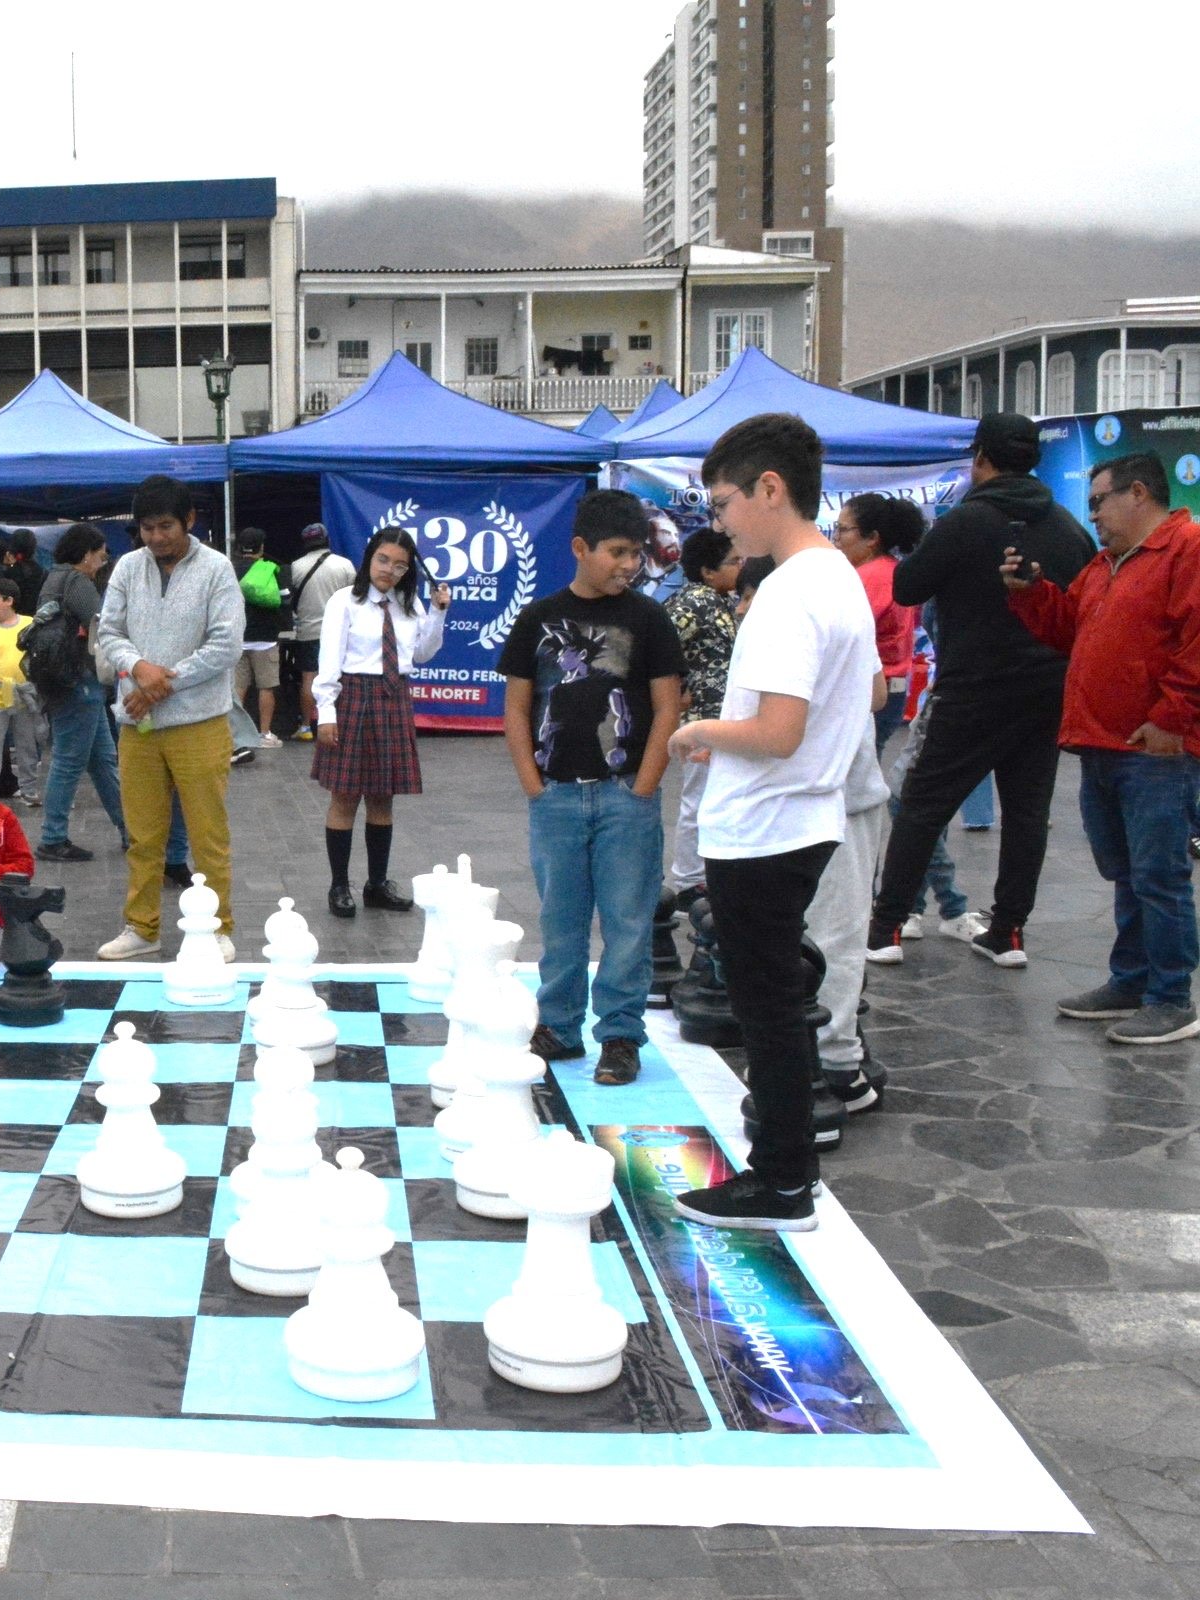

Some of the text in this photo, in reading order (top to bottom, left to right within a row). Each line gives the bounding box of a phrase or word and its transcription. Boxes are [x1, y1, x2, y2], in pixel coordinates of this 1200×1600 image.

[423, 516, 508, 580] 30
[467, 574, 497, 586] años
[423, 581, 497, 601] Lnza
[450, 620, 479, 631] 2024
[409, 667, 469, 681] CENTRO
[409, 686, 480, 701] EL NORTE
